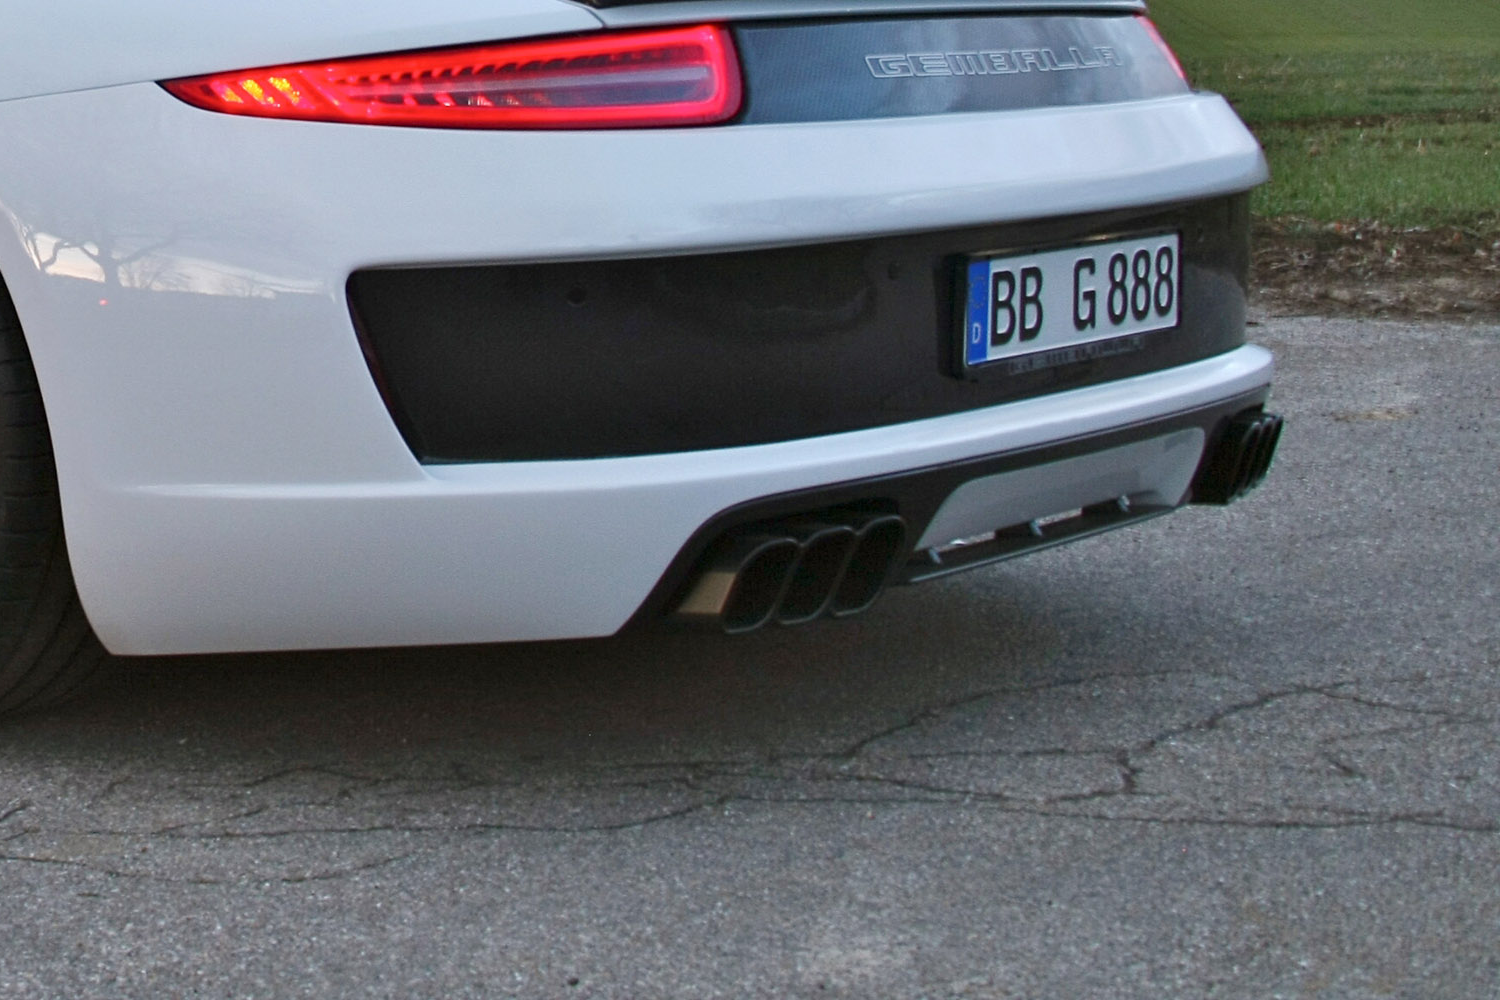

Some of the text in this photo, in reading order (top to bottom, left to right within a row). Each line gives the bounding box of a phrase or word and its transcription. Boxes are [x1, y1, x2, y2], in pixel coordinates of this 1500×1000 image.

[864, 47, 1124, 79] GEMBALLA
[990, 266, 1043, 347] BB
[972, 322, 981, 344] D
